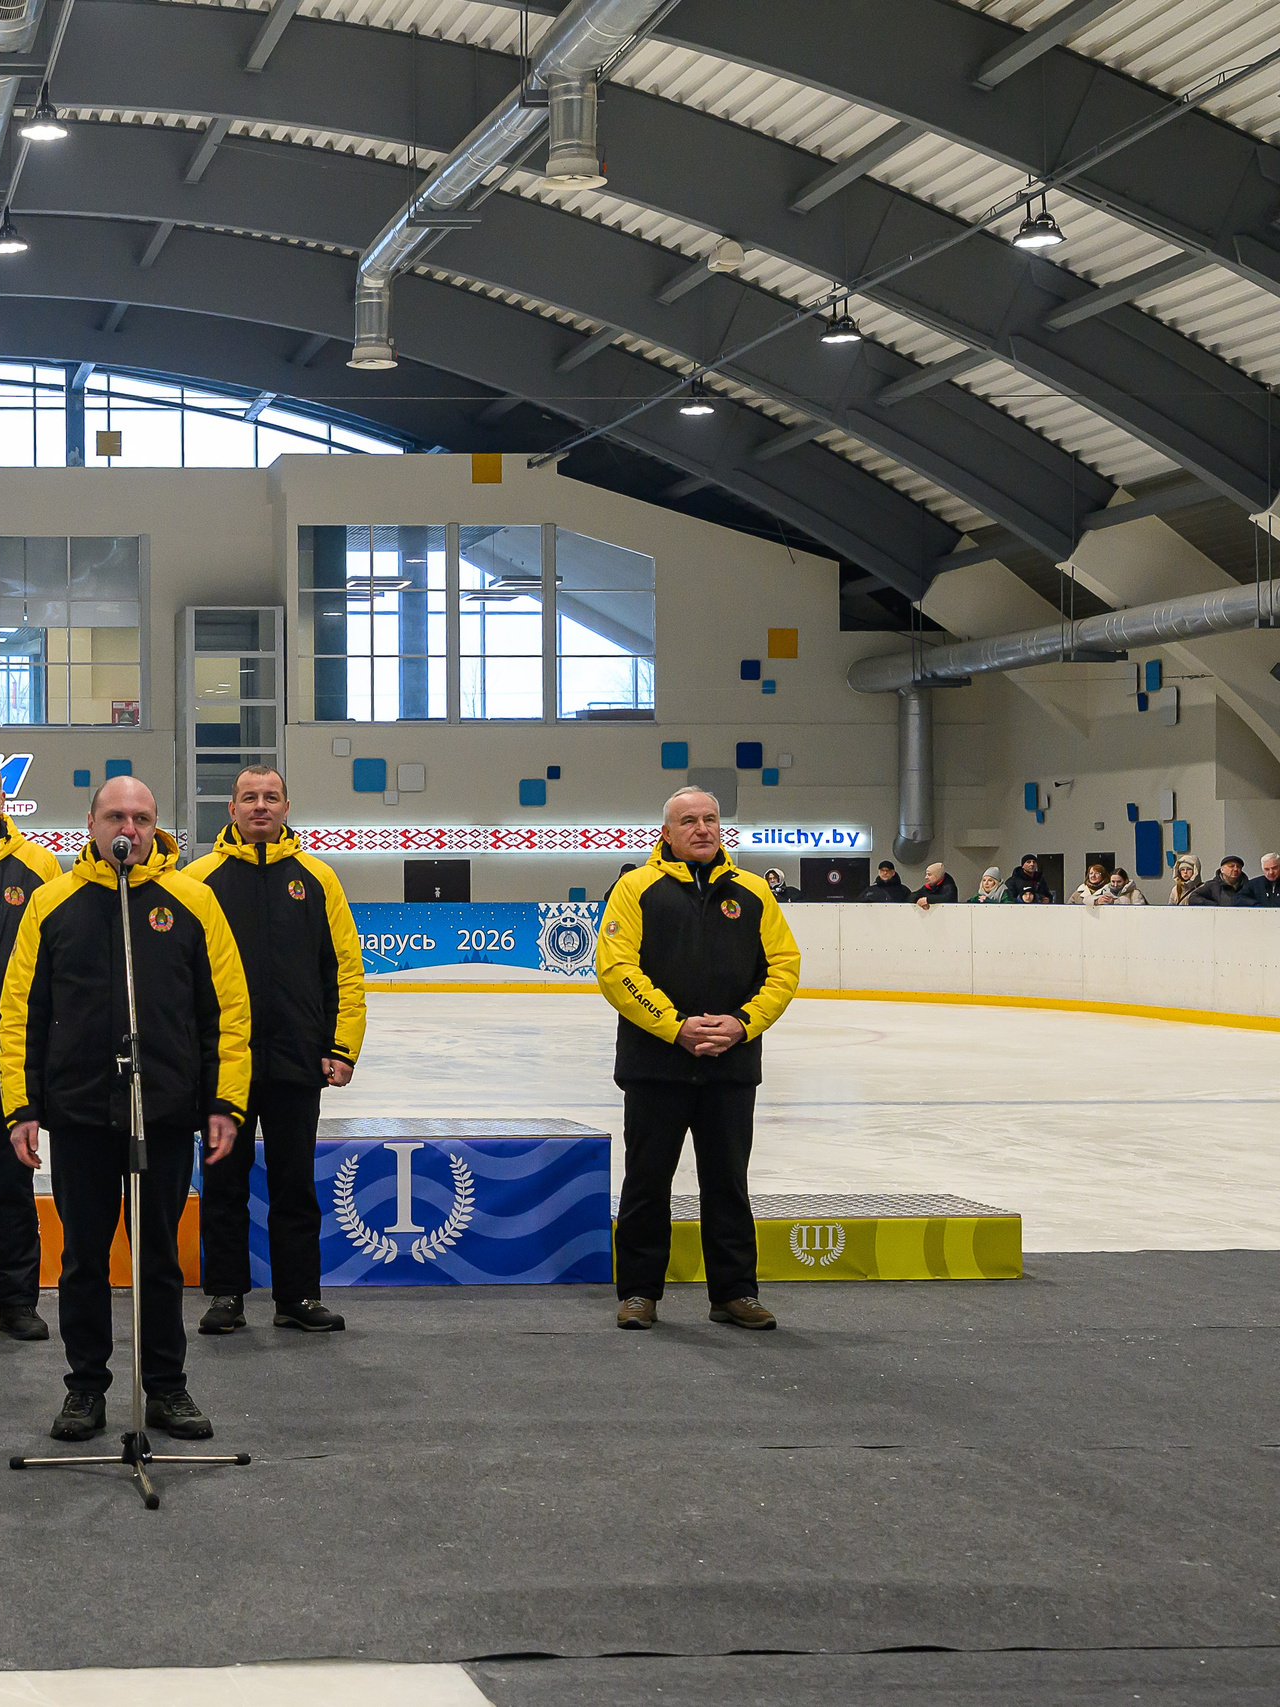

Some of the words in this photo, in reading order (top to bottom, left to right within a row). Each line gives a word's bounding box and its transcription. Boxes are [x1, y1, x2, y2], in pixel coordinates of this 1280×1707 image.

[751, 828, 860, 848] silichy.by
[456, 929, 516, 951] 2026
[621, 976, 664, 1019] BELARUS
